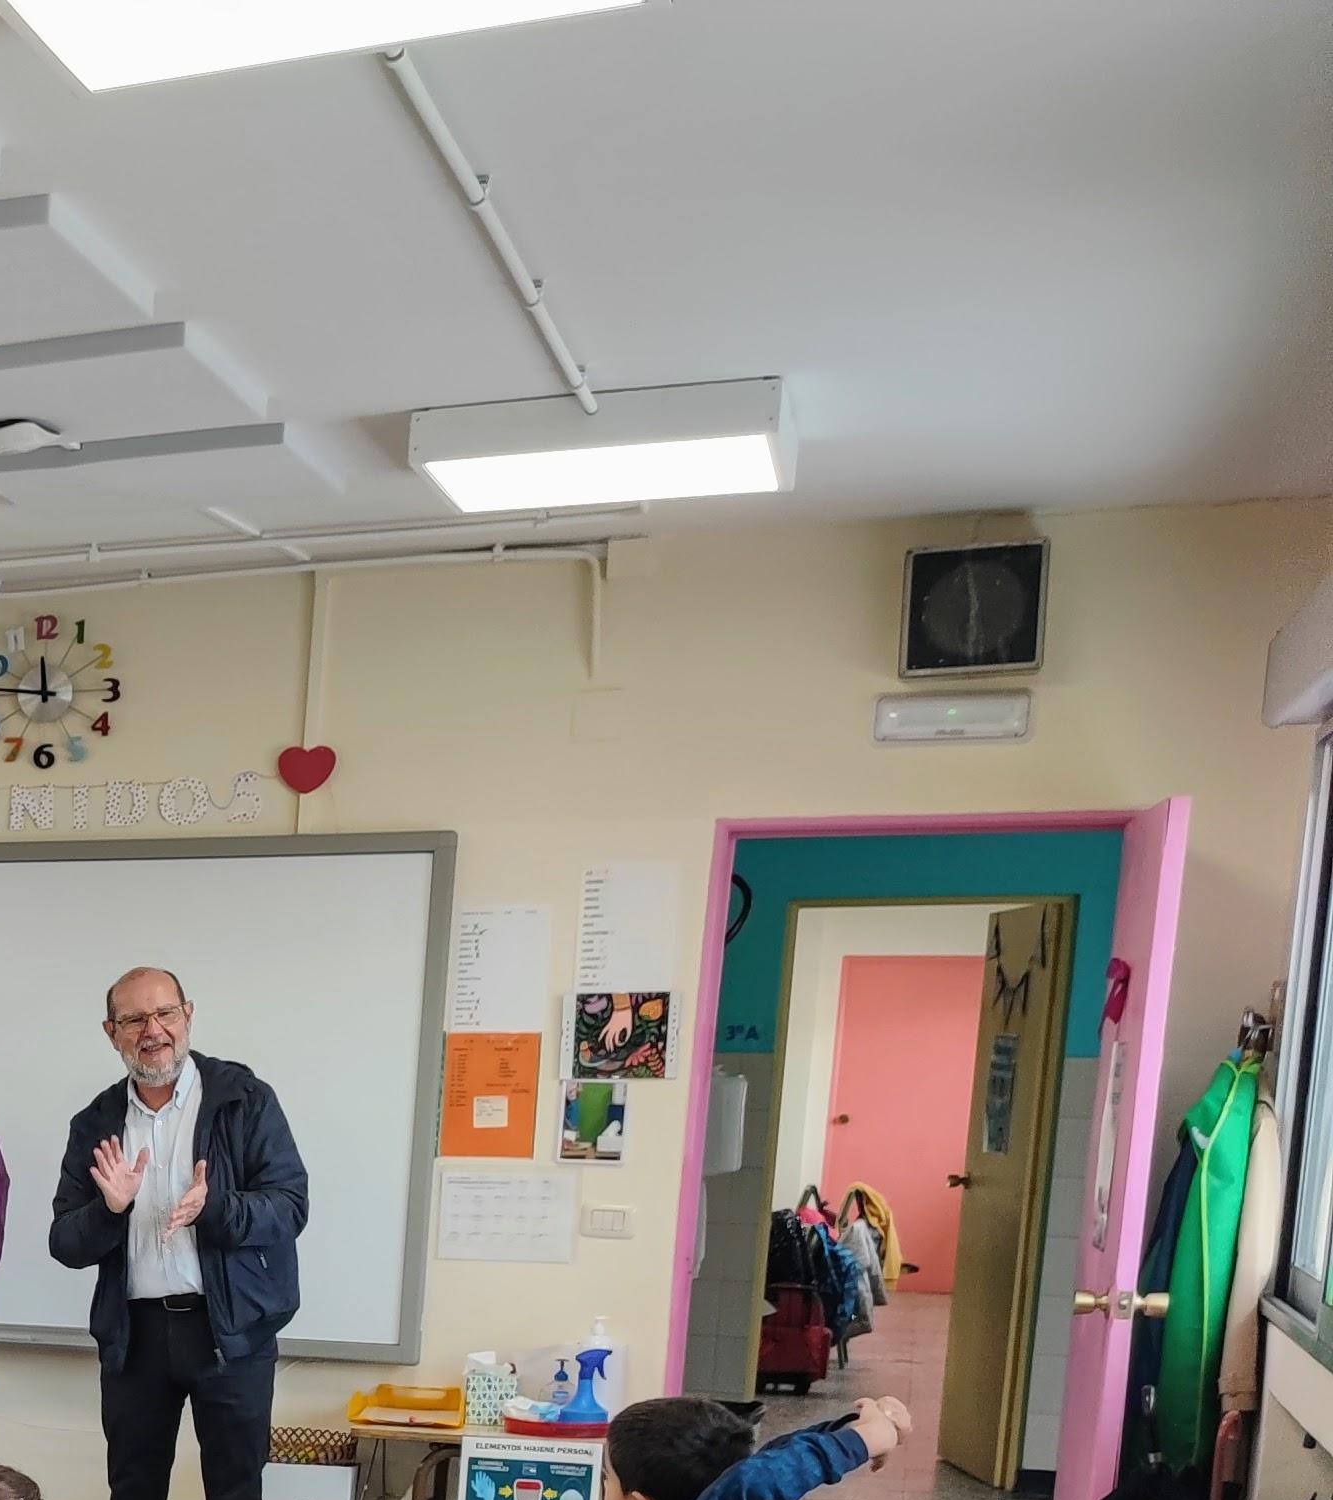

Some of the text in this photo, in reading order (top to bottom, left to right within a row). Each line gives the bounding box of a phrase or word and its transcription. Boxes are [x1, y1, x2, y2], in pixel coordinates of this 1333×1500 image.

[35, 614, 59, 640] 12
[75, 619, 85, 644] 1
[93, 643, 113, 669] 2
[102, 678, 121, 702] 3
[91, 711, 111, 736] 4
[4, 736, 23, 763] 7
[33, 743, 55, 769] 6
[68, 736, 88, 762] 5
[475, 1442, 593, 1456] ELEMENTOS HIGIENE PERSOAL
